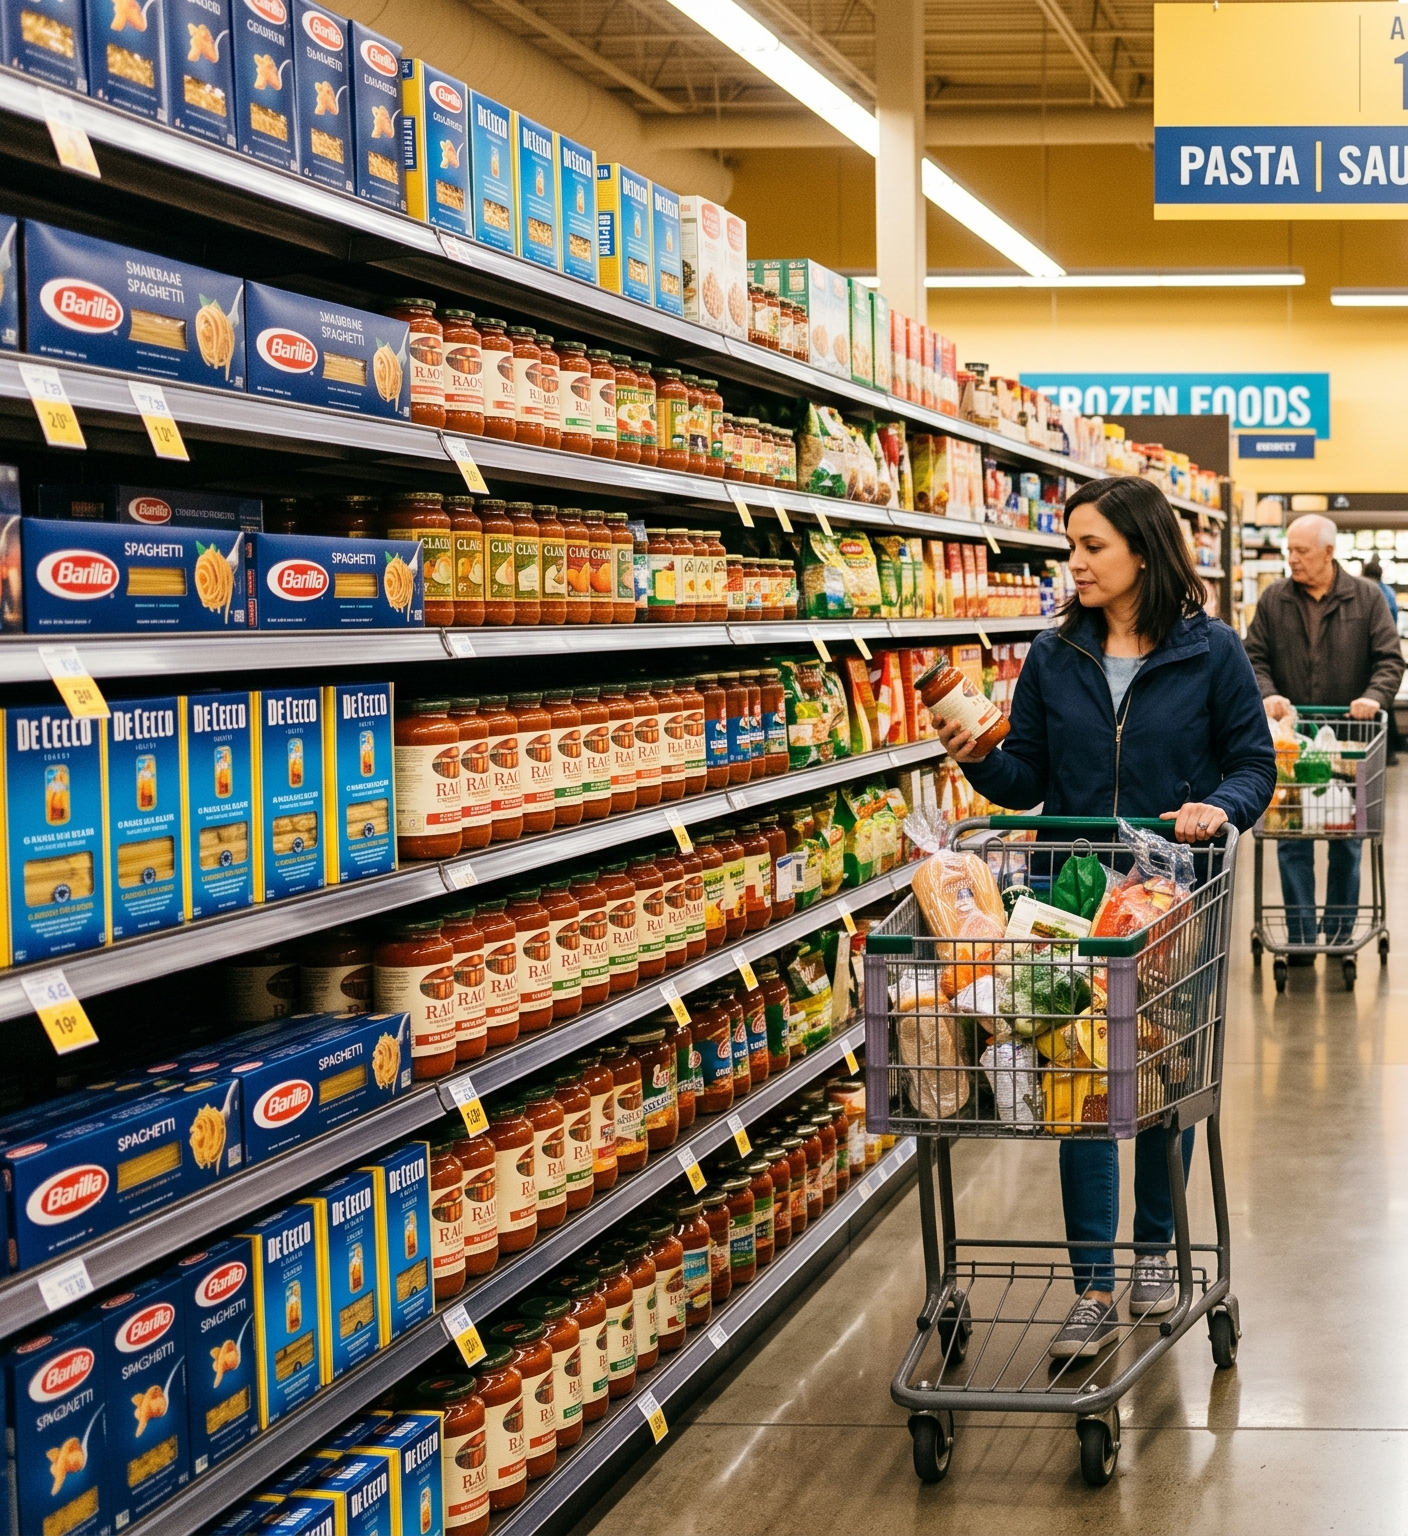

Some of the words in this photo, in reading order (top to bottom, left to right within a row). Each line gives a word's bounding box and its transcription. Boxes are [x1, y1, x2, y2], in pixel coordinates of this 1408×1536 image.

[1180, 145, 1300, 186] PASTA
[60, 290, 117, 321] Barilla
[128, 278, 184, 304] SPAGHETTI
[271, 337, 313, 363] Barilla
[1191, 385, 1311, 426] FOODS
[124, 542, 183, 557] SPAGHETTI
[332, 552, 376, 565] SPAGHETTI
[57, 562, 112, 585] Barilla
[282, 569, 324, 589] Barilla
[318, 1043, 363, 1071] SPAGHETTI
[268, 1088, 307, 1117] Barilla
[118, 1117, 176, 1153] SPAGHETTI
[47, 1173, 102, 1212] Barilla
[208, 1267, 244, 1298] Barilla
[129, 1309, 171, 1344] Barilla
[45, 1354, 90, 1391] Barilla
